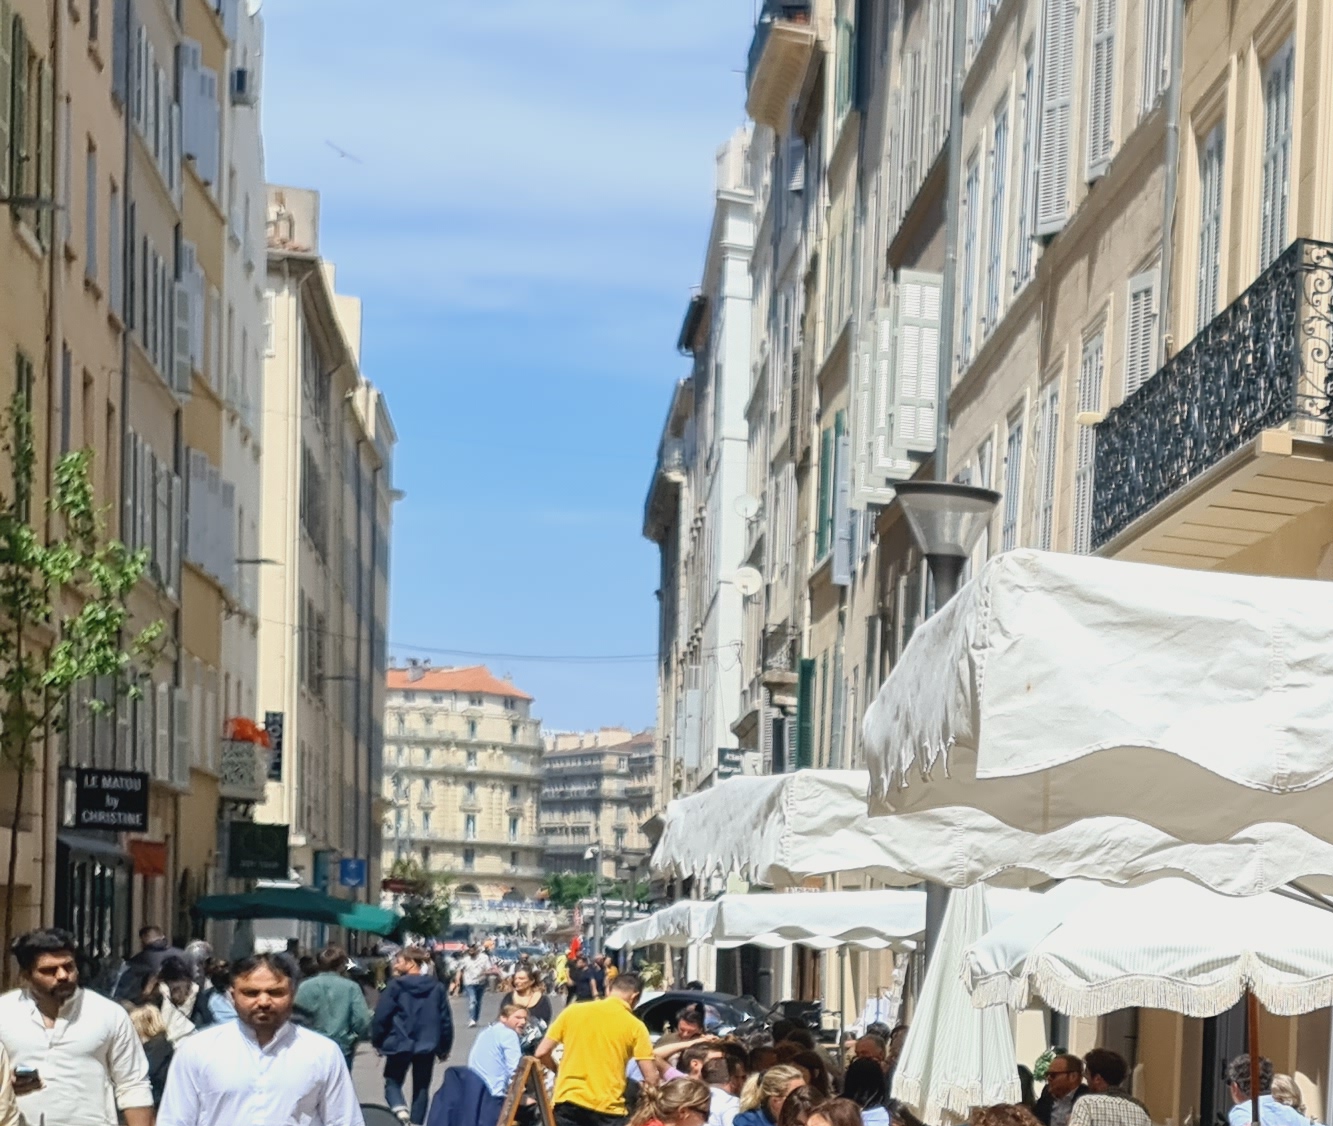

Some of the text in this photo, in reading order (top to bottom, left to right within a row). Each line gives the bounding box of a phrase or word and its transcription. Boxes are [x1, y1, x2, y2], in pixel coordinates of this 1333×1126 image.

[83, 774, 142, 792] LE MATOU
[105, 792, 120, 810] by
[81, 809, 143, 826] CHRISTINE
